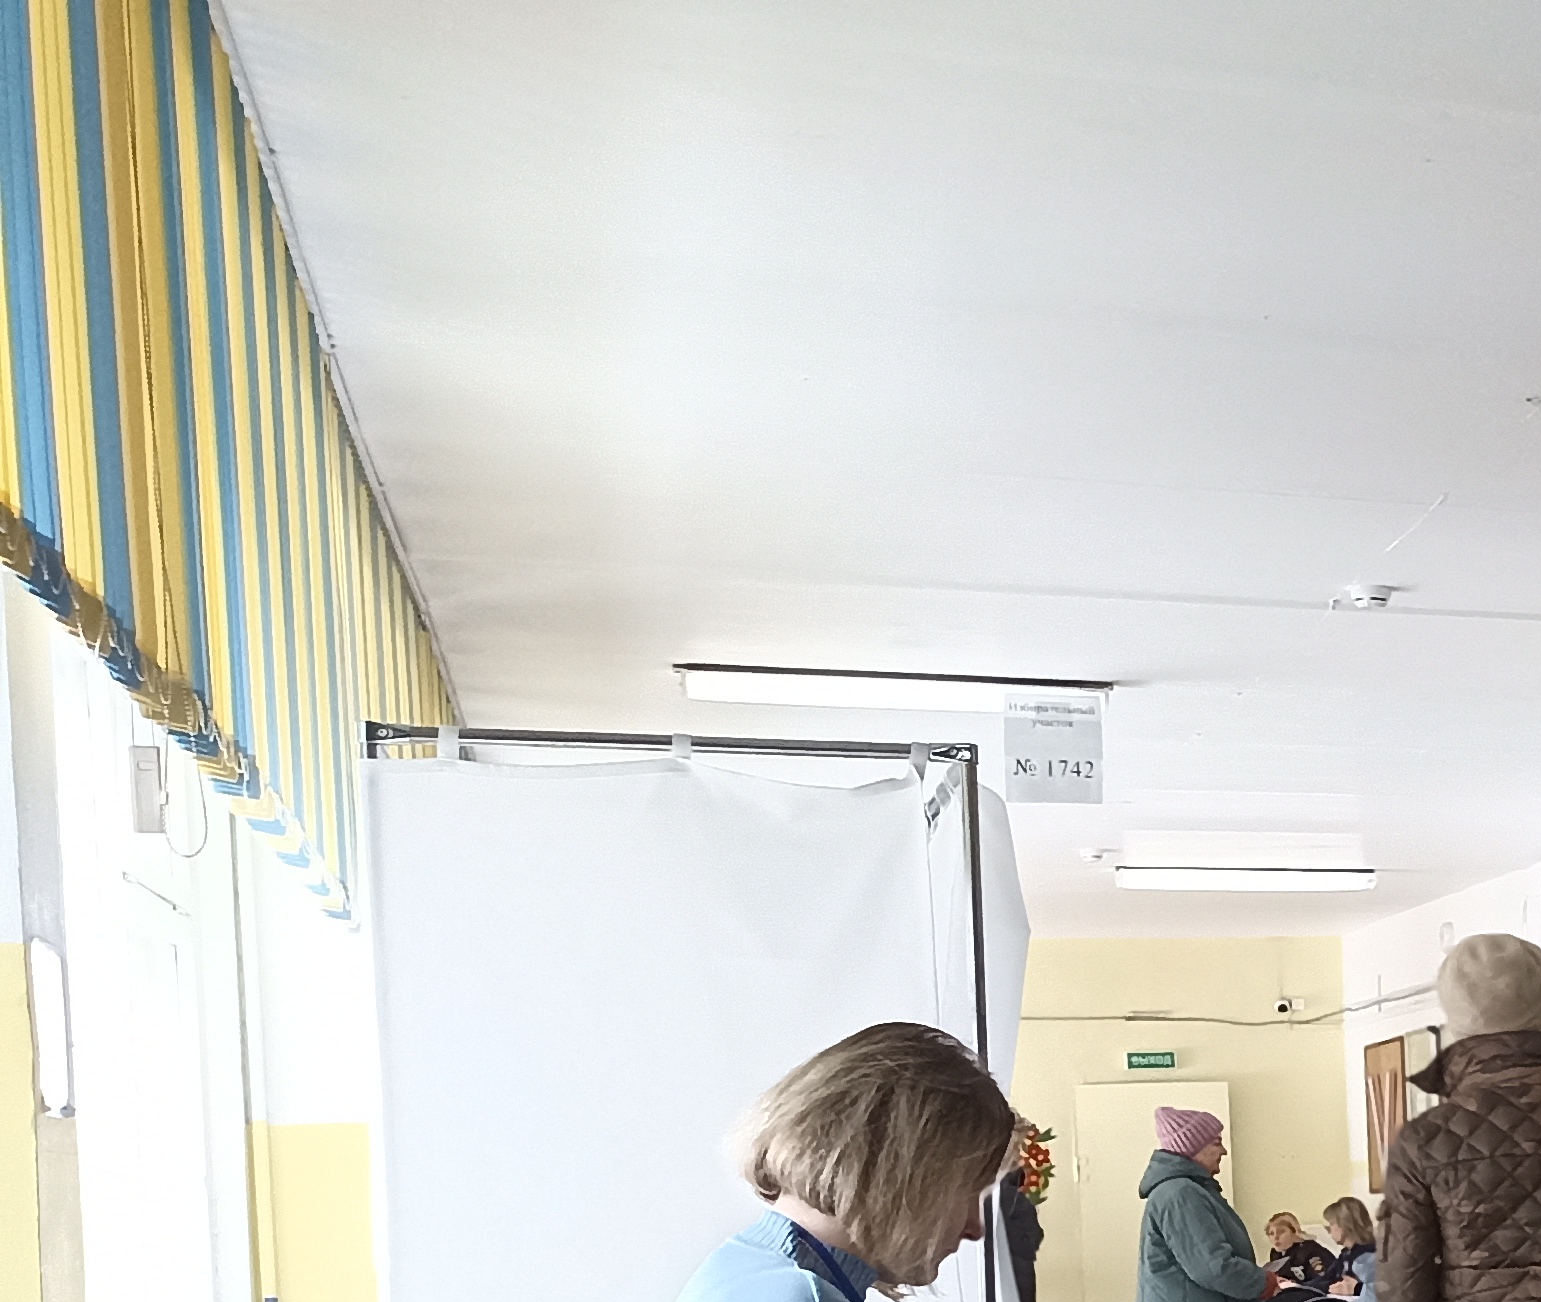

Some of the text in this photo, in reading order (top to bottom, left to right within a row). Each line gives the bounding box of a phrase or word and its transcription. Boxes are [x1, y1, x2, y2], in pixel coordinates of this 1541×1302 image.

[1013, 758, 1095, 779] № 1742
[1130, 1055, 1172, 1066] ВЫХОД
